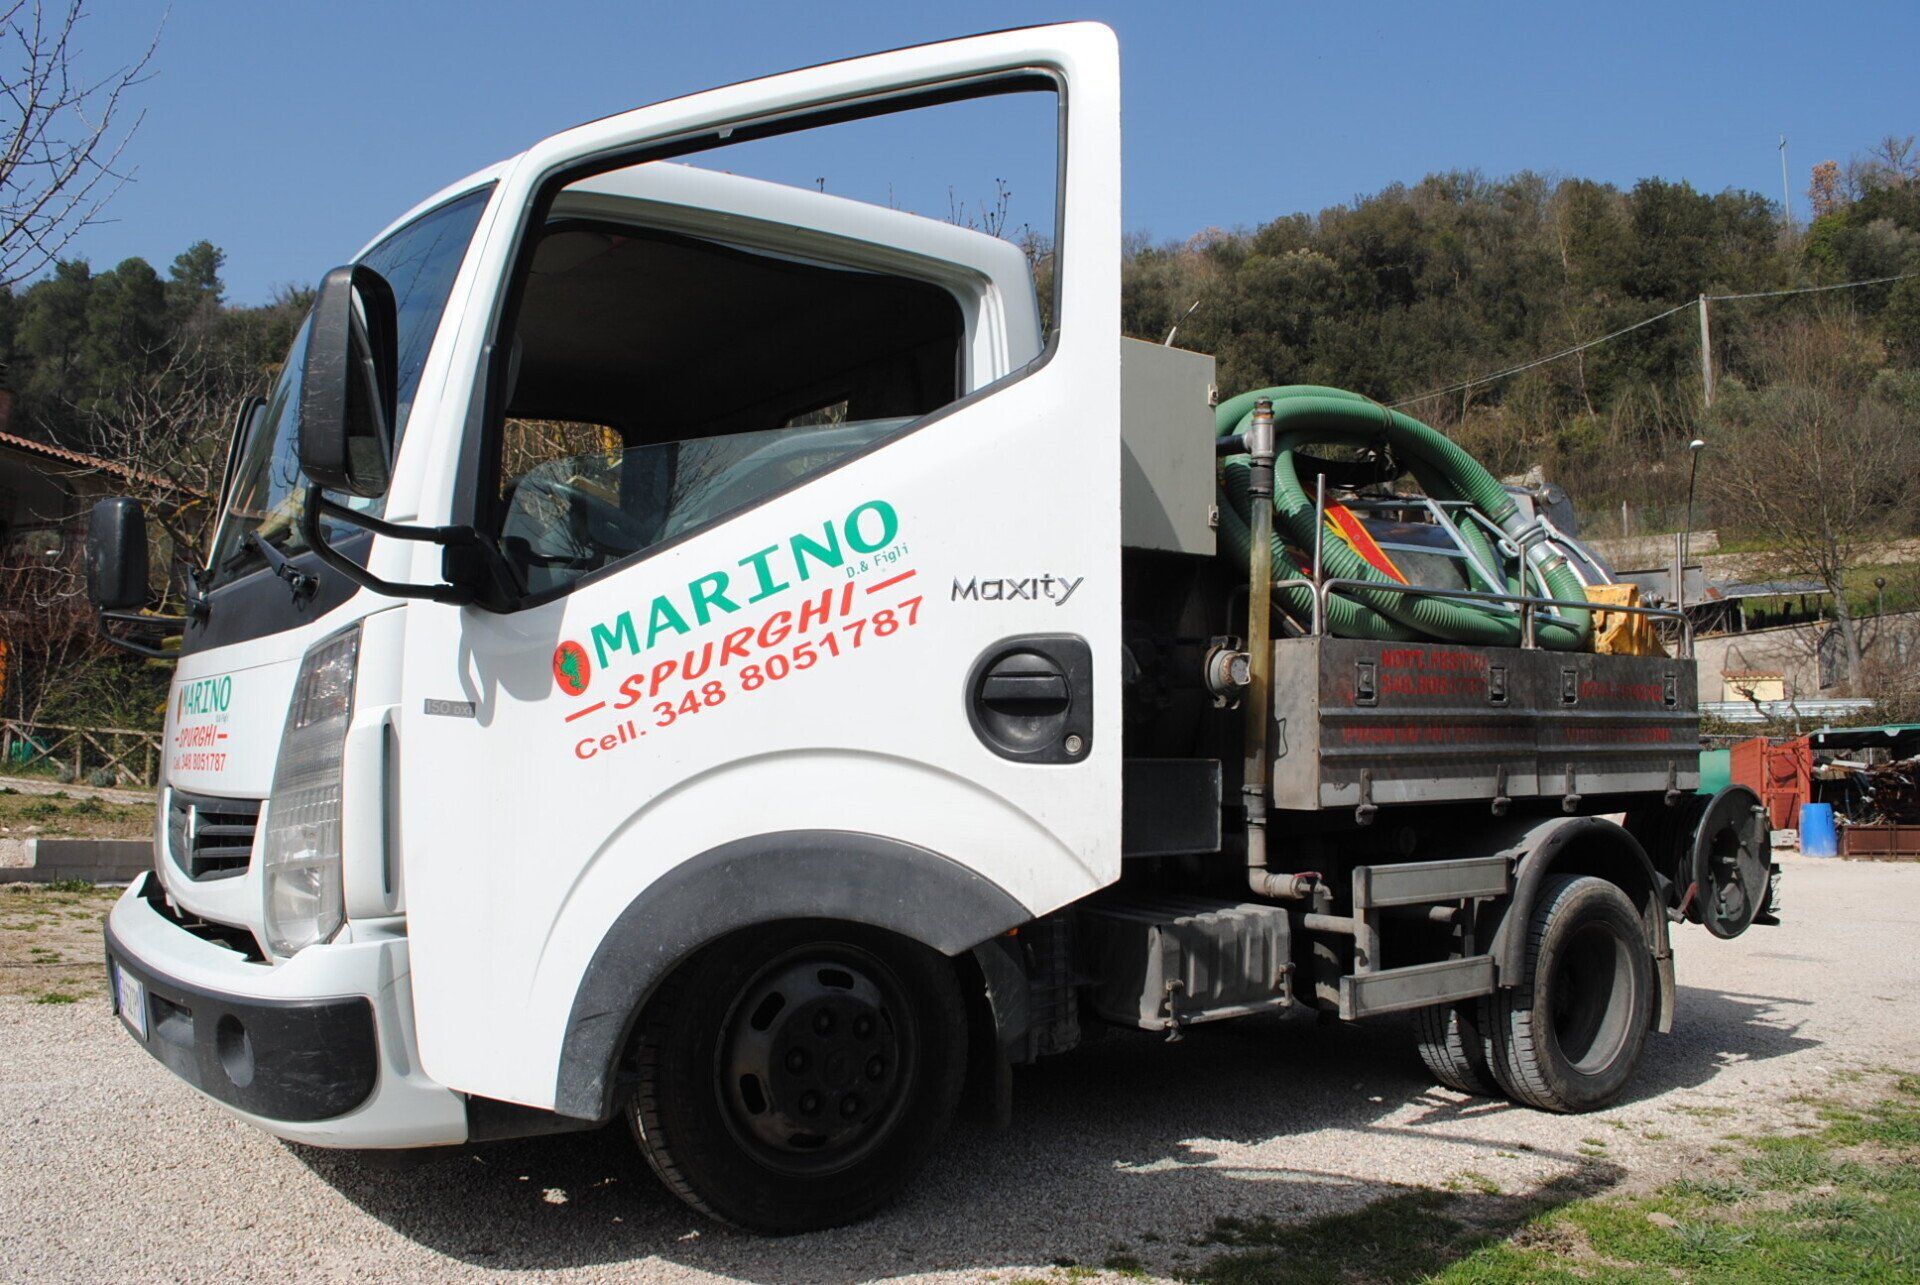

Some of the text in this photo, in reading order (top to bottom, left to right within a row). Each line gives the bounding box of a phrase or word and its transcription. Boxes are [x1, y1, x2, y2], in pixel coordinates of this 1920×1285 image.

[873, 542, 909, 568] Figli
[590, 500, 899, 670] MARINO
[951, 573, 1085, 607] Maxity
[613, 581, 855, 710] SPURGHI
[574, 595, 924, 760] Cell. 348 8051787
[183, 675, 232, 715] MARINO
[426, 700, 451, 714] 150
[179, 724, 217, 748] SPURGHI
[193, 753, 227, 772] 8051787
